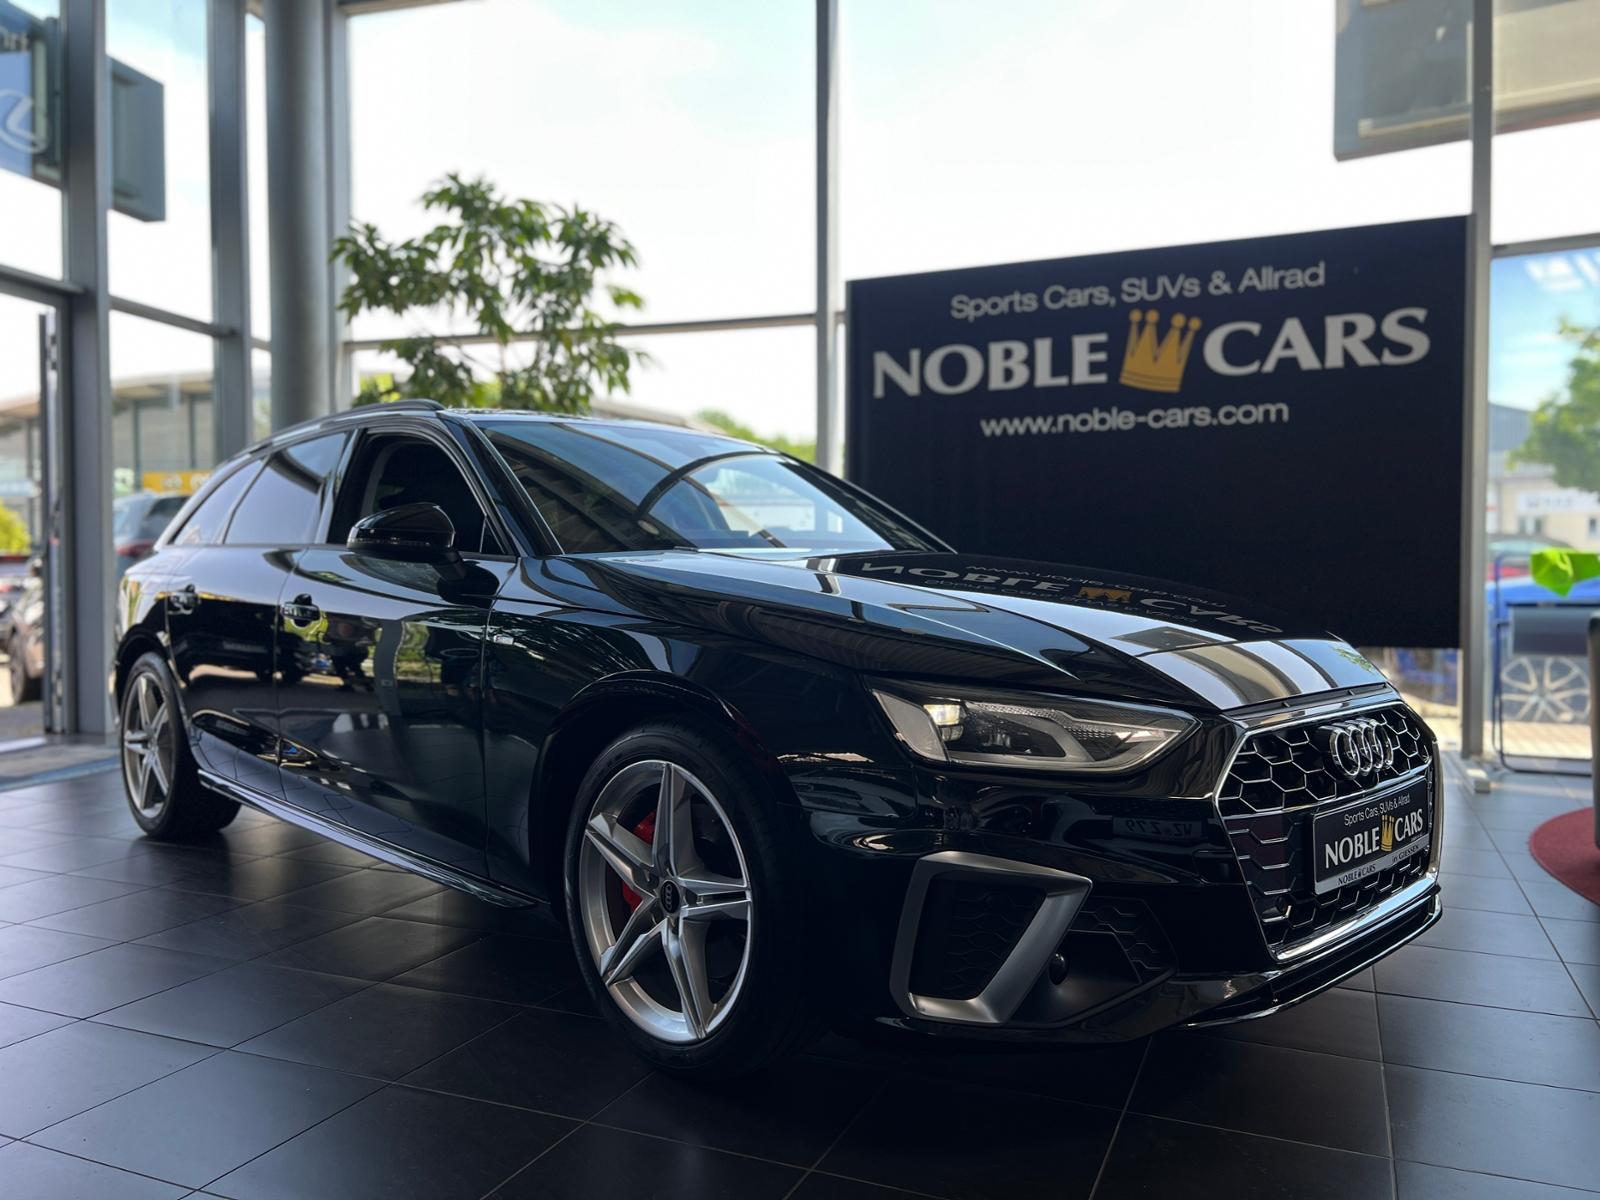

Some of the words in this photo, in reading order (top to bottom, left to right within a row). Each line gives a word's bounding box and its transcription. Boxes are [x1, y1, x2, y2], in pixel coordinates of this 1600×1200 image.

[950, 290, 1039, 323] Sports
[1043, 284, 1117, 308] Cars,
[1120, 273, 1202, 303] SUVs
[1208, 270, 1233, 296] &
[1238, 260, 1326, 293] Allrad
[872, 332, 1109, 400] NOBLE
[1202, 306, 1431, 377] CARS
[979, 401, 1290, 438] www.noble-cars.com
[1344, 812, 1365, 827] Sports
[1380, 800, 1394, 815] SUVs
[1325, 826, 1380, 869] NOBLE
[1394, 808, 1423, 842] CARS
[1337, 869, 1359, 886] NOBLE
[1361, 863, 1377, 877] CARS
